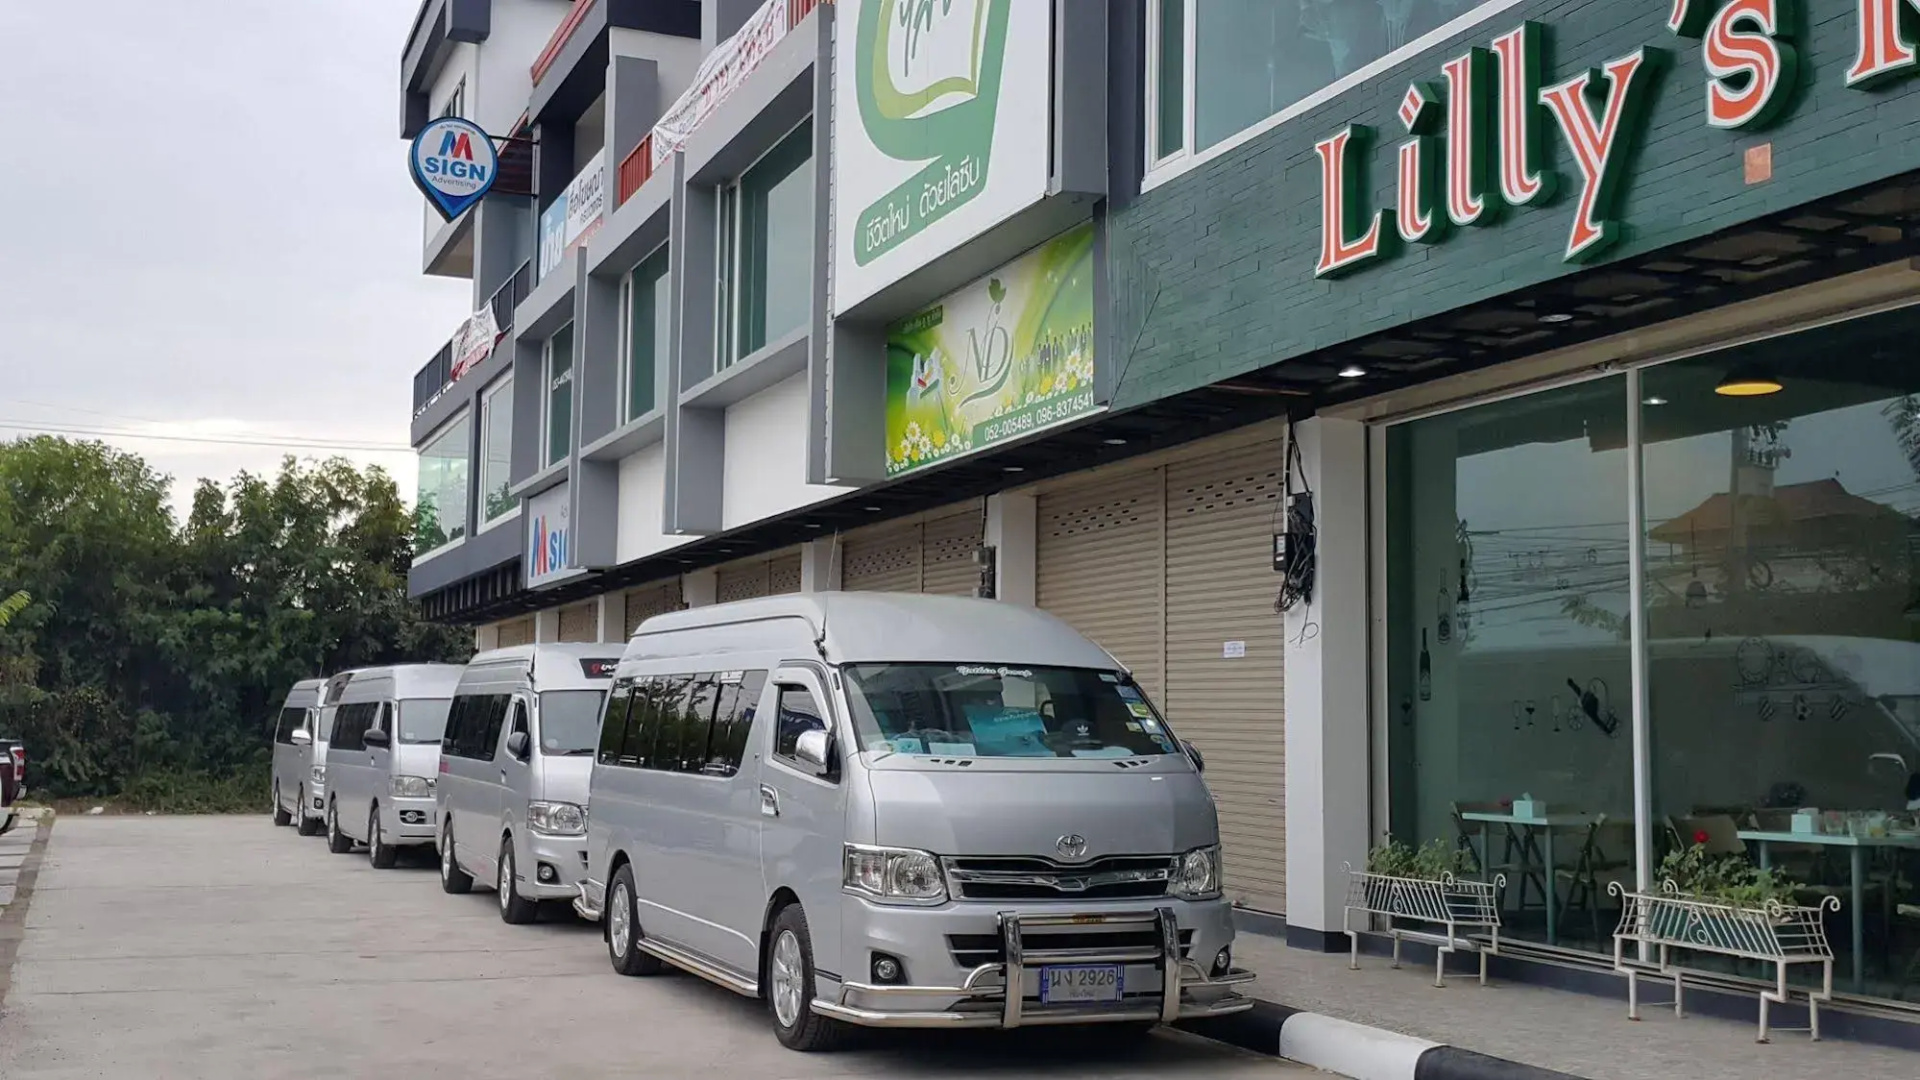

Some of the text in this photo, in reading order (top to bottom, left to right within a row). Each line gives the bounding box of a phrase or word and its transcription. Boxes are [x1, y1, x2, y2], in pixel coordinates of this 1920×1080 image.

[424, 157, 486, 181] SIGN
[431, 175, 477, 189] Advertising
[866, 195, 910, 252] ชีวิตใหม่
[1036, 390, 1094, 424] 096-8374541
[1078, 968, 1115, 987] 2926
